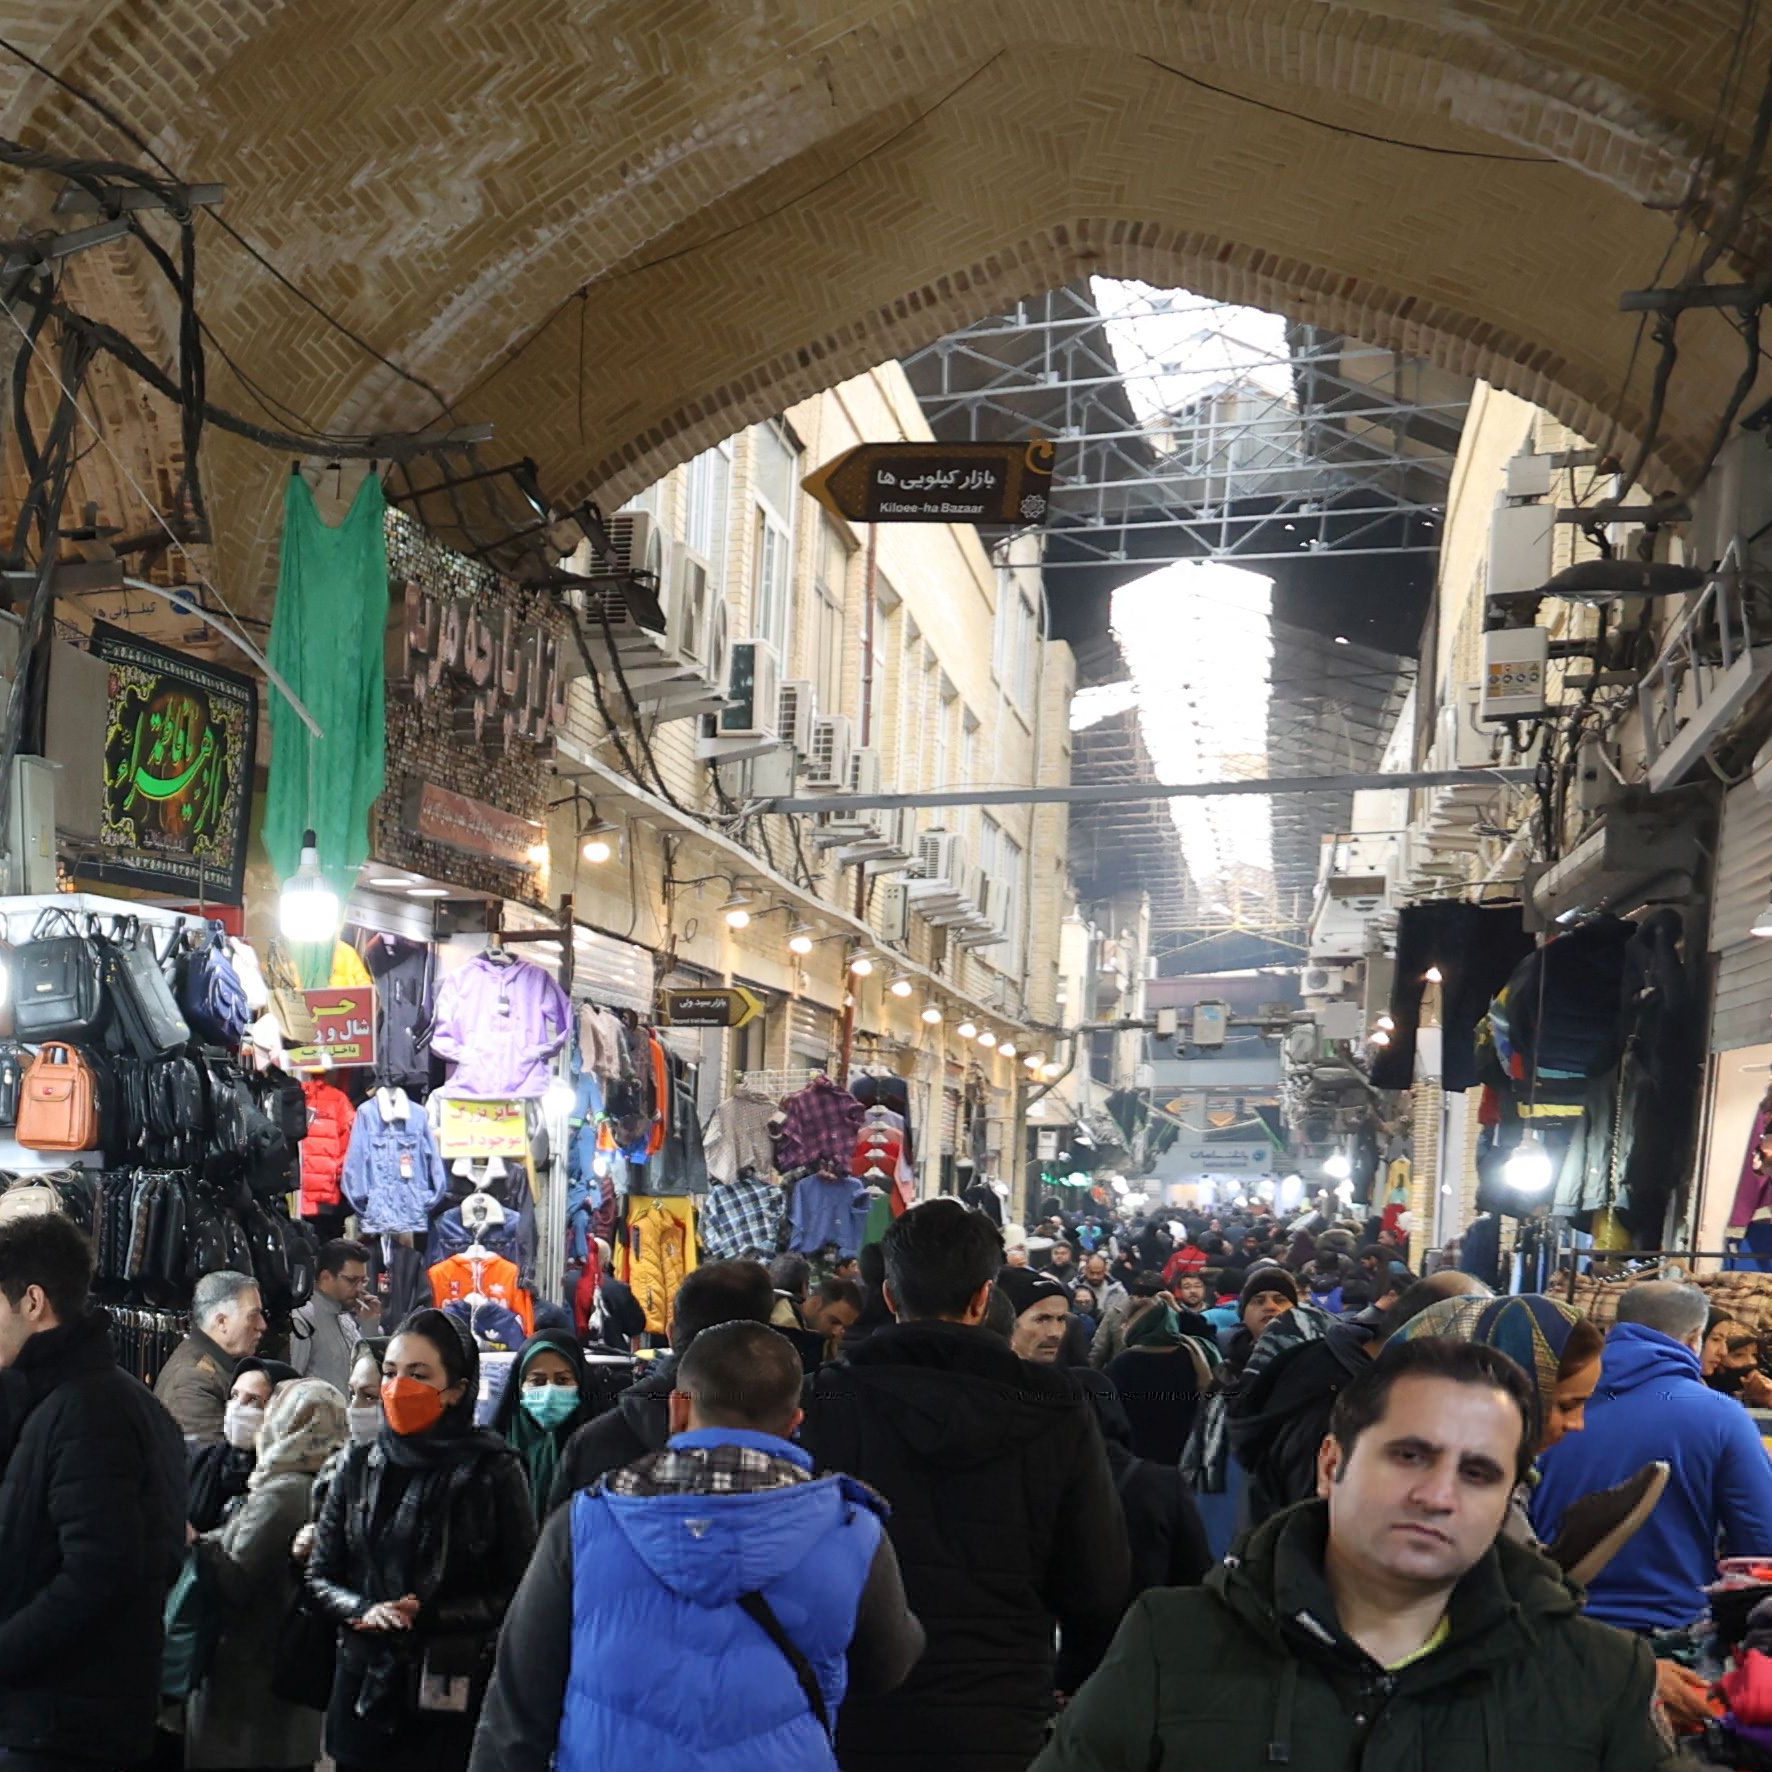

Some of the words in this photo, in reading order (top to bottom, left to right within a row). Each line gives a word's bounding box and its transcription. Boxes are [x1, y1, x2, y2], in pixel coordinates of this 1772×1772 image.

[876, 469, 896, 485] ها
[900, 469, 960, 491] کیلویی
[957, 469, 996, 490] بازار
[880, 502, 938, 513] Kiloee-ha
[941, 502, 984, 514] Bazaar
[326, 1026, 337, 1042] و
[340, 1018, 370, 1041] شال
